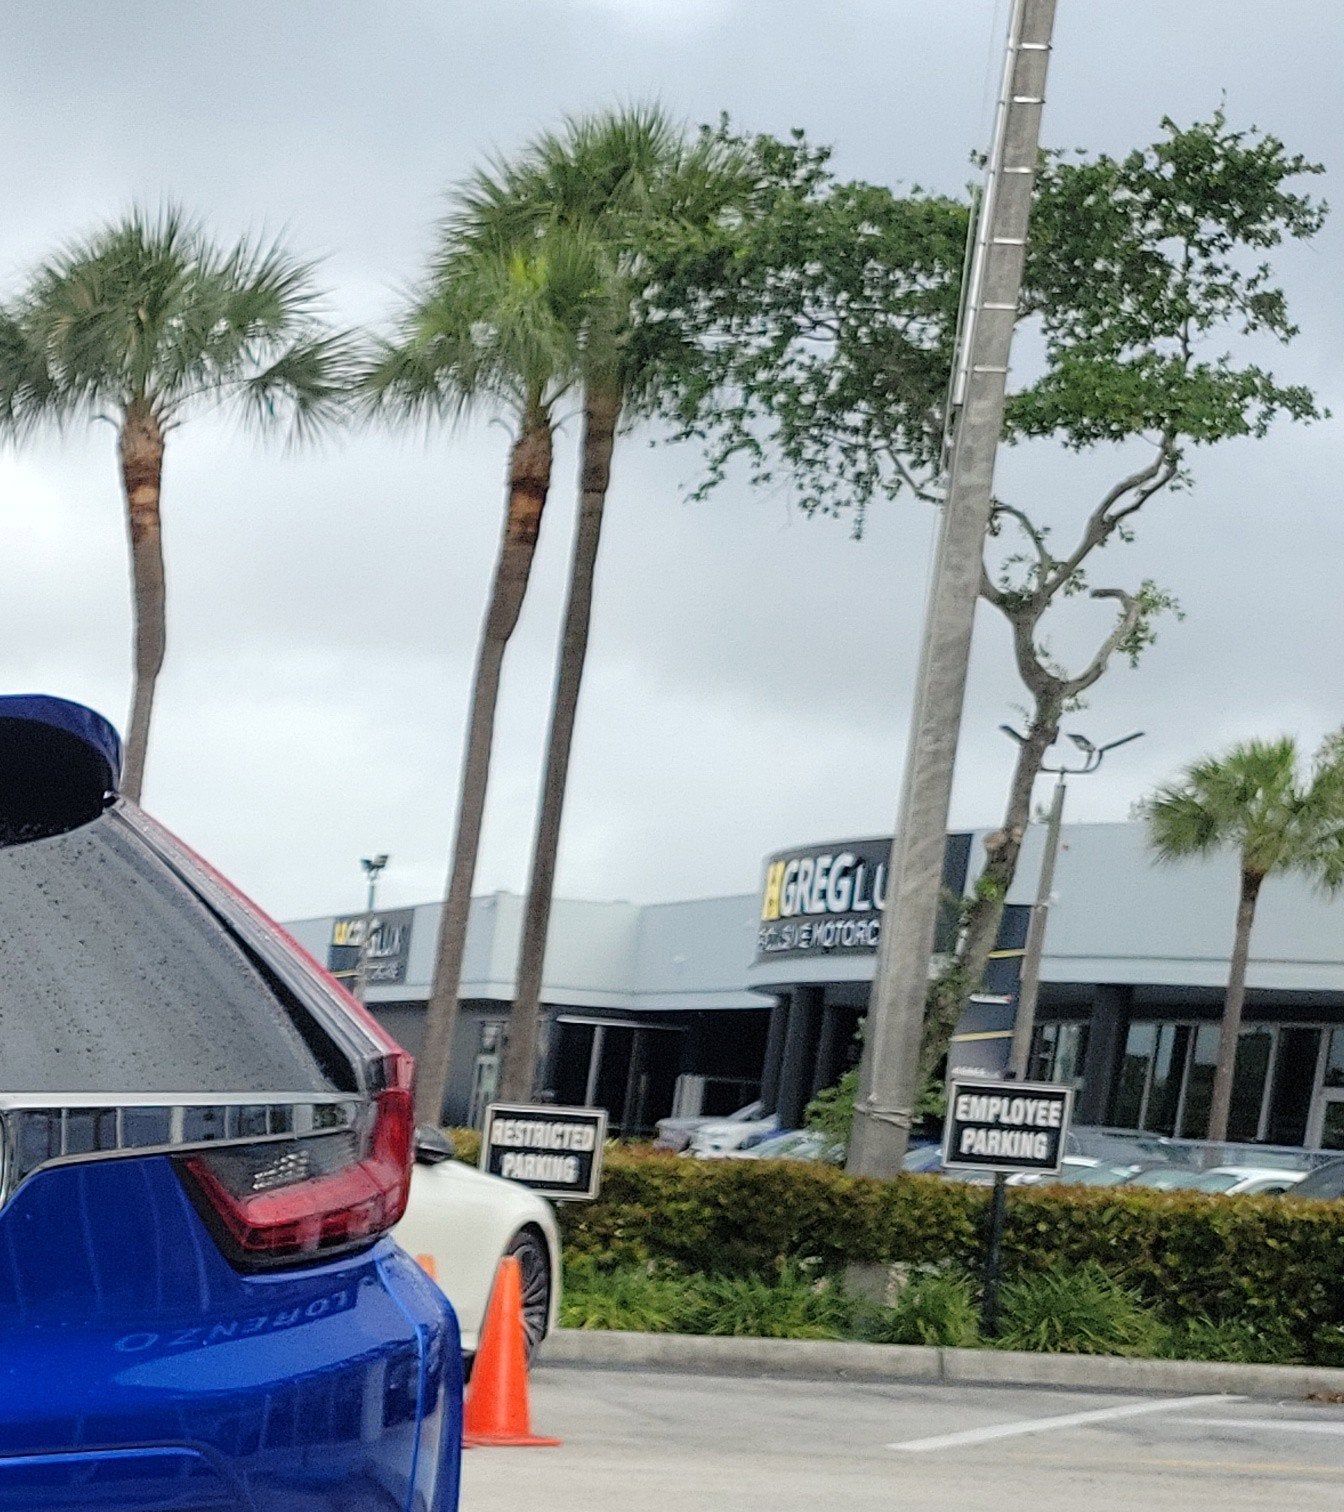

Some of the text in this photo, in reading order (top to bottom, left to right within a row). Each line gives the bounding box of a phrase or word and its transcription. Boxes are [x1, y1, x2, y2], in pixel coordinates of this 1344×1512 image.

[955, 1093, 1062, 1128] EMPLOYEE
[490, 1118, 595, 1152] RESTRICTED
[959, 1126, 1049, 1160] PARKING
[501, 1151, 580, 1183] PARKING
